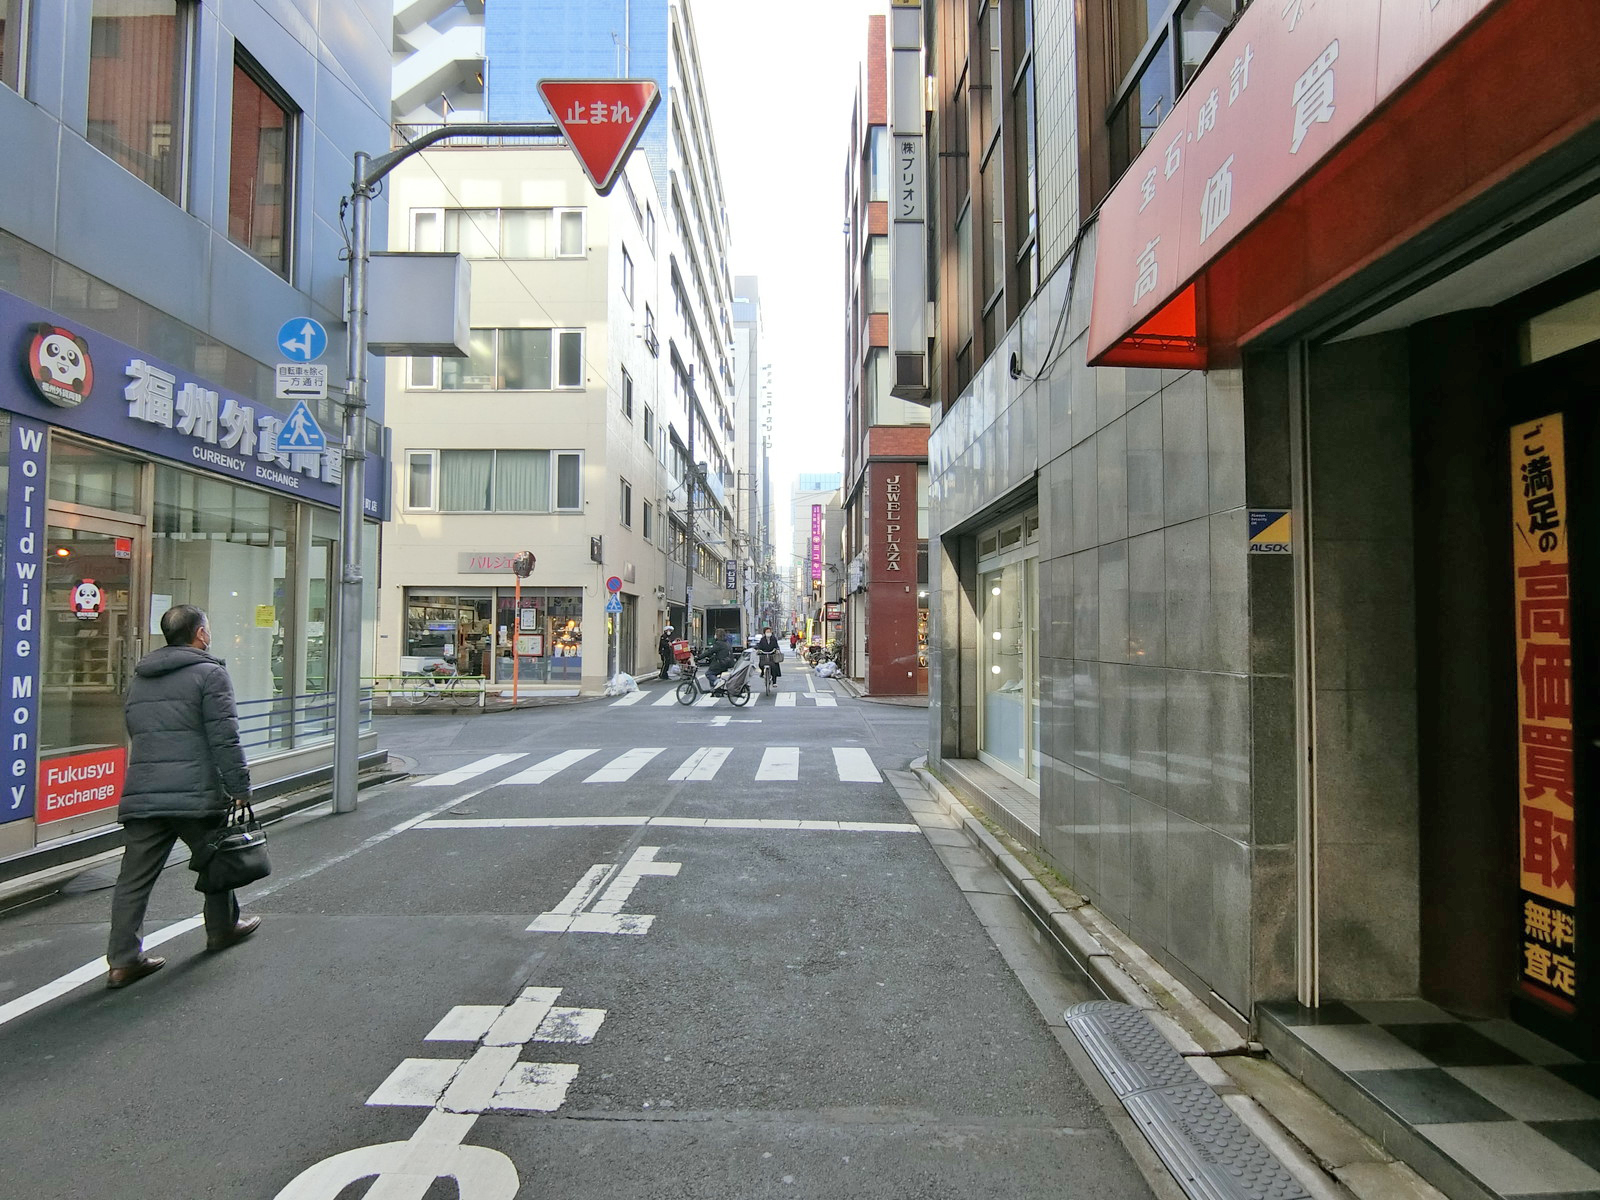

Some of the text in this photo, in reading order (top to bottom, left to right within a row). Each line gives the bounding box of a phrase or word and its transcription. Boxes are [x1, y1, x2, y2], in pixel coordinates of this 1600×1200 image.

[564, 100, 634, 125] 止まれ
[1132, 0, 1441, 307] 高価買
[279, 366, 324, 376] 自転車を除く
[279, 377, 324, 387] 一方通行
[192, 446, 299, 488] CURRENCY EXCHANGE
[1519, 422, 1560, 553] ご満足の
[886, 474, 901, 571] JEWEL PLAZA
[1250, 543, 1289, 552] ALSOK
[11, 427, 43, 810] Worldwide Money
[1518, 560, 1574, 889] 高価買取
[46, 783, 115, 810] Exchange
[47, 761, 115, 786] Fukusyu
[1523, 899, 1575, 949] 無料
[1523, 940, 1576, 997] 査定
